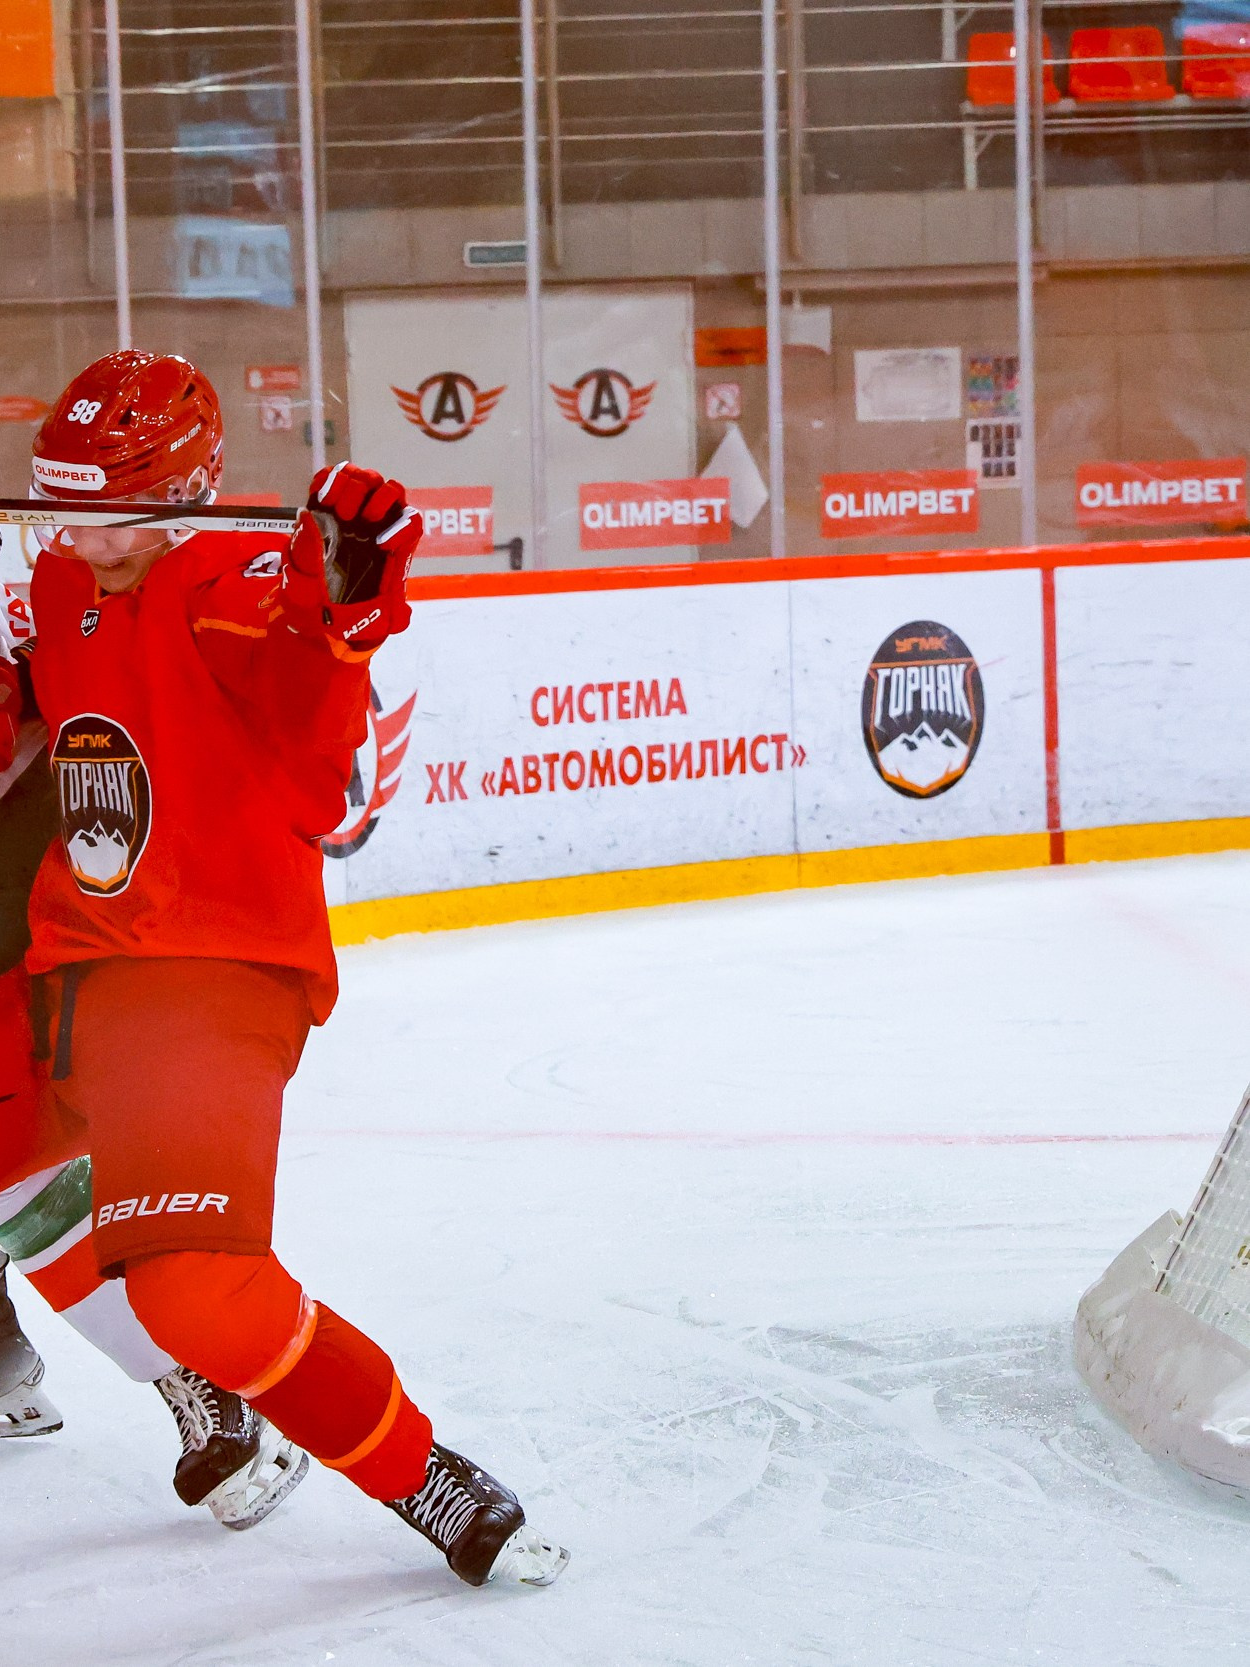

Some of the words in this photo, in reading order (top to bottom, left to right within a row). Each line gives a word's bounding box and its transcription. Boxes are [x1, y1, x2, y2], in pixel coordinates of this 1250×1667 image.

[67, 399, 102, 425] 98
[170, 423, 202, 452] BAUER
[35, 464, 98, 482] OLIMPBET
[825, 488, 975, 519] OLIMPBET
[1080, 478, 1242, 508] OLIMPBET
[235, 520, 289, 529] BAUER
[424, 508, 491, 536] PBET
[583, 498, 726, 529] OLIMPBET
[343, 608, 381, 640] CCM
[895, 634, 948, 653] УГМК
[531, 677, 687, 727] СИСТЕМА
[874, 663, 971, 728] ГОРНЯК
[68, 734, 112, 748] УГМК
[425, 760, 467, 802] ХК
[481, 733, 807, 797] «АВТОМОБИЛИСТ»
[59, 762, 134, 819] ГОРНЯК
[96, 1192, 229, 1229] BAUER
